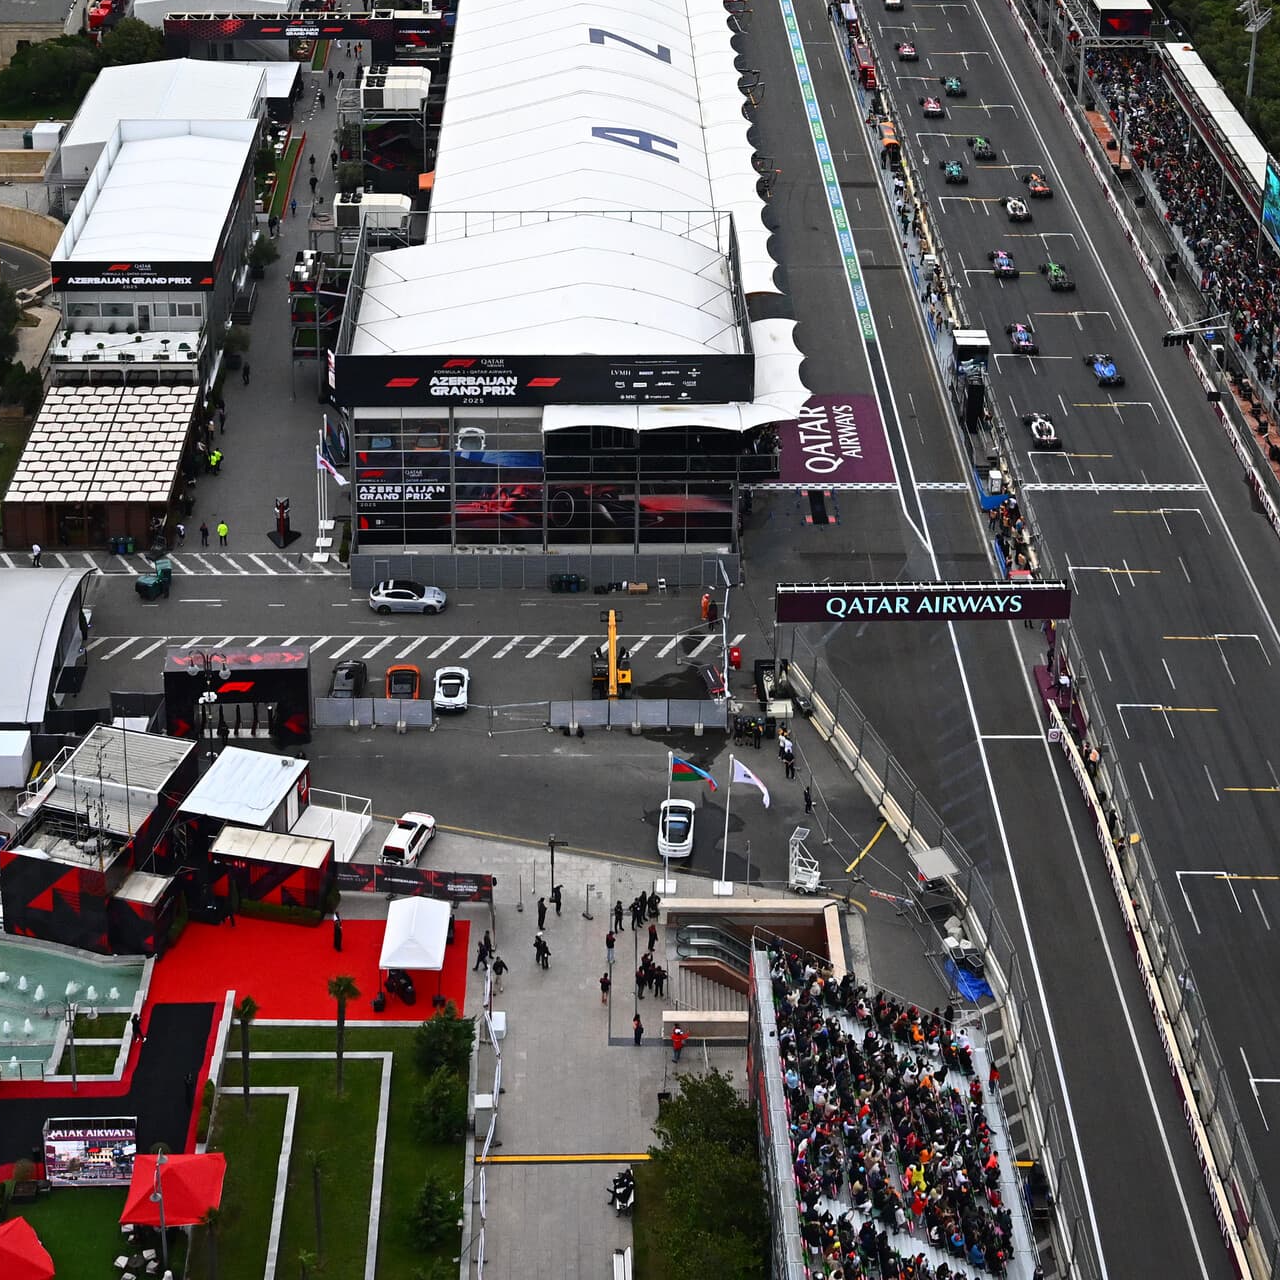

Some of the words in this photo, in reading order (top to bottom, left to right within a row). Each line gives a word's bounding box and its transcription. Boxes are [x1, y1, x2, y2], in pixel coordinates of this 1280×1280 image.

[67, 277, 130, 285] AZERBAIJAN
[168, 277, 192, 285] PRIX
[860, 312, 873, 336] aramco
[429, 376, 518, 386] AZERBAIJAN
[430, 386, 481, 396] GRAND
[483, 386, 516, 396] PRIX
[797, 405, 845, 474] QATAR
[831, 404, 864, 459] AIRWAYS
[359, 485, 446, 494] AZERBAIJAN
[825, 596, 911, 619] QATAR
[916, 594, 1023, 614] AIRWAYS
